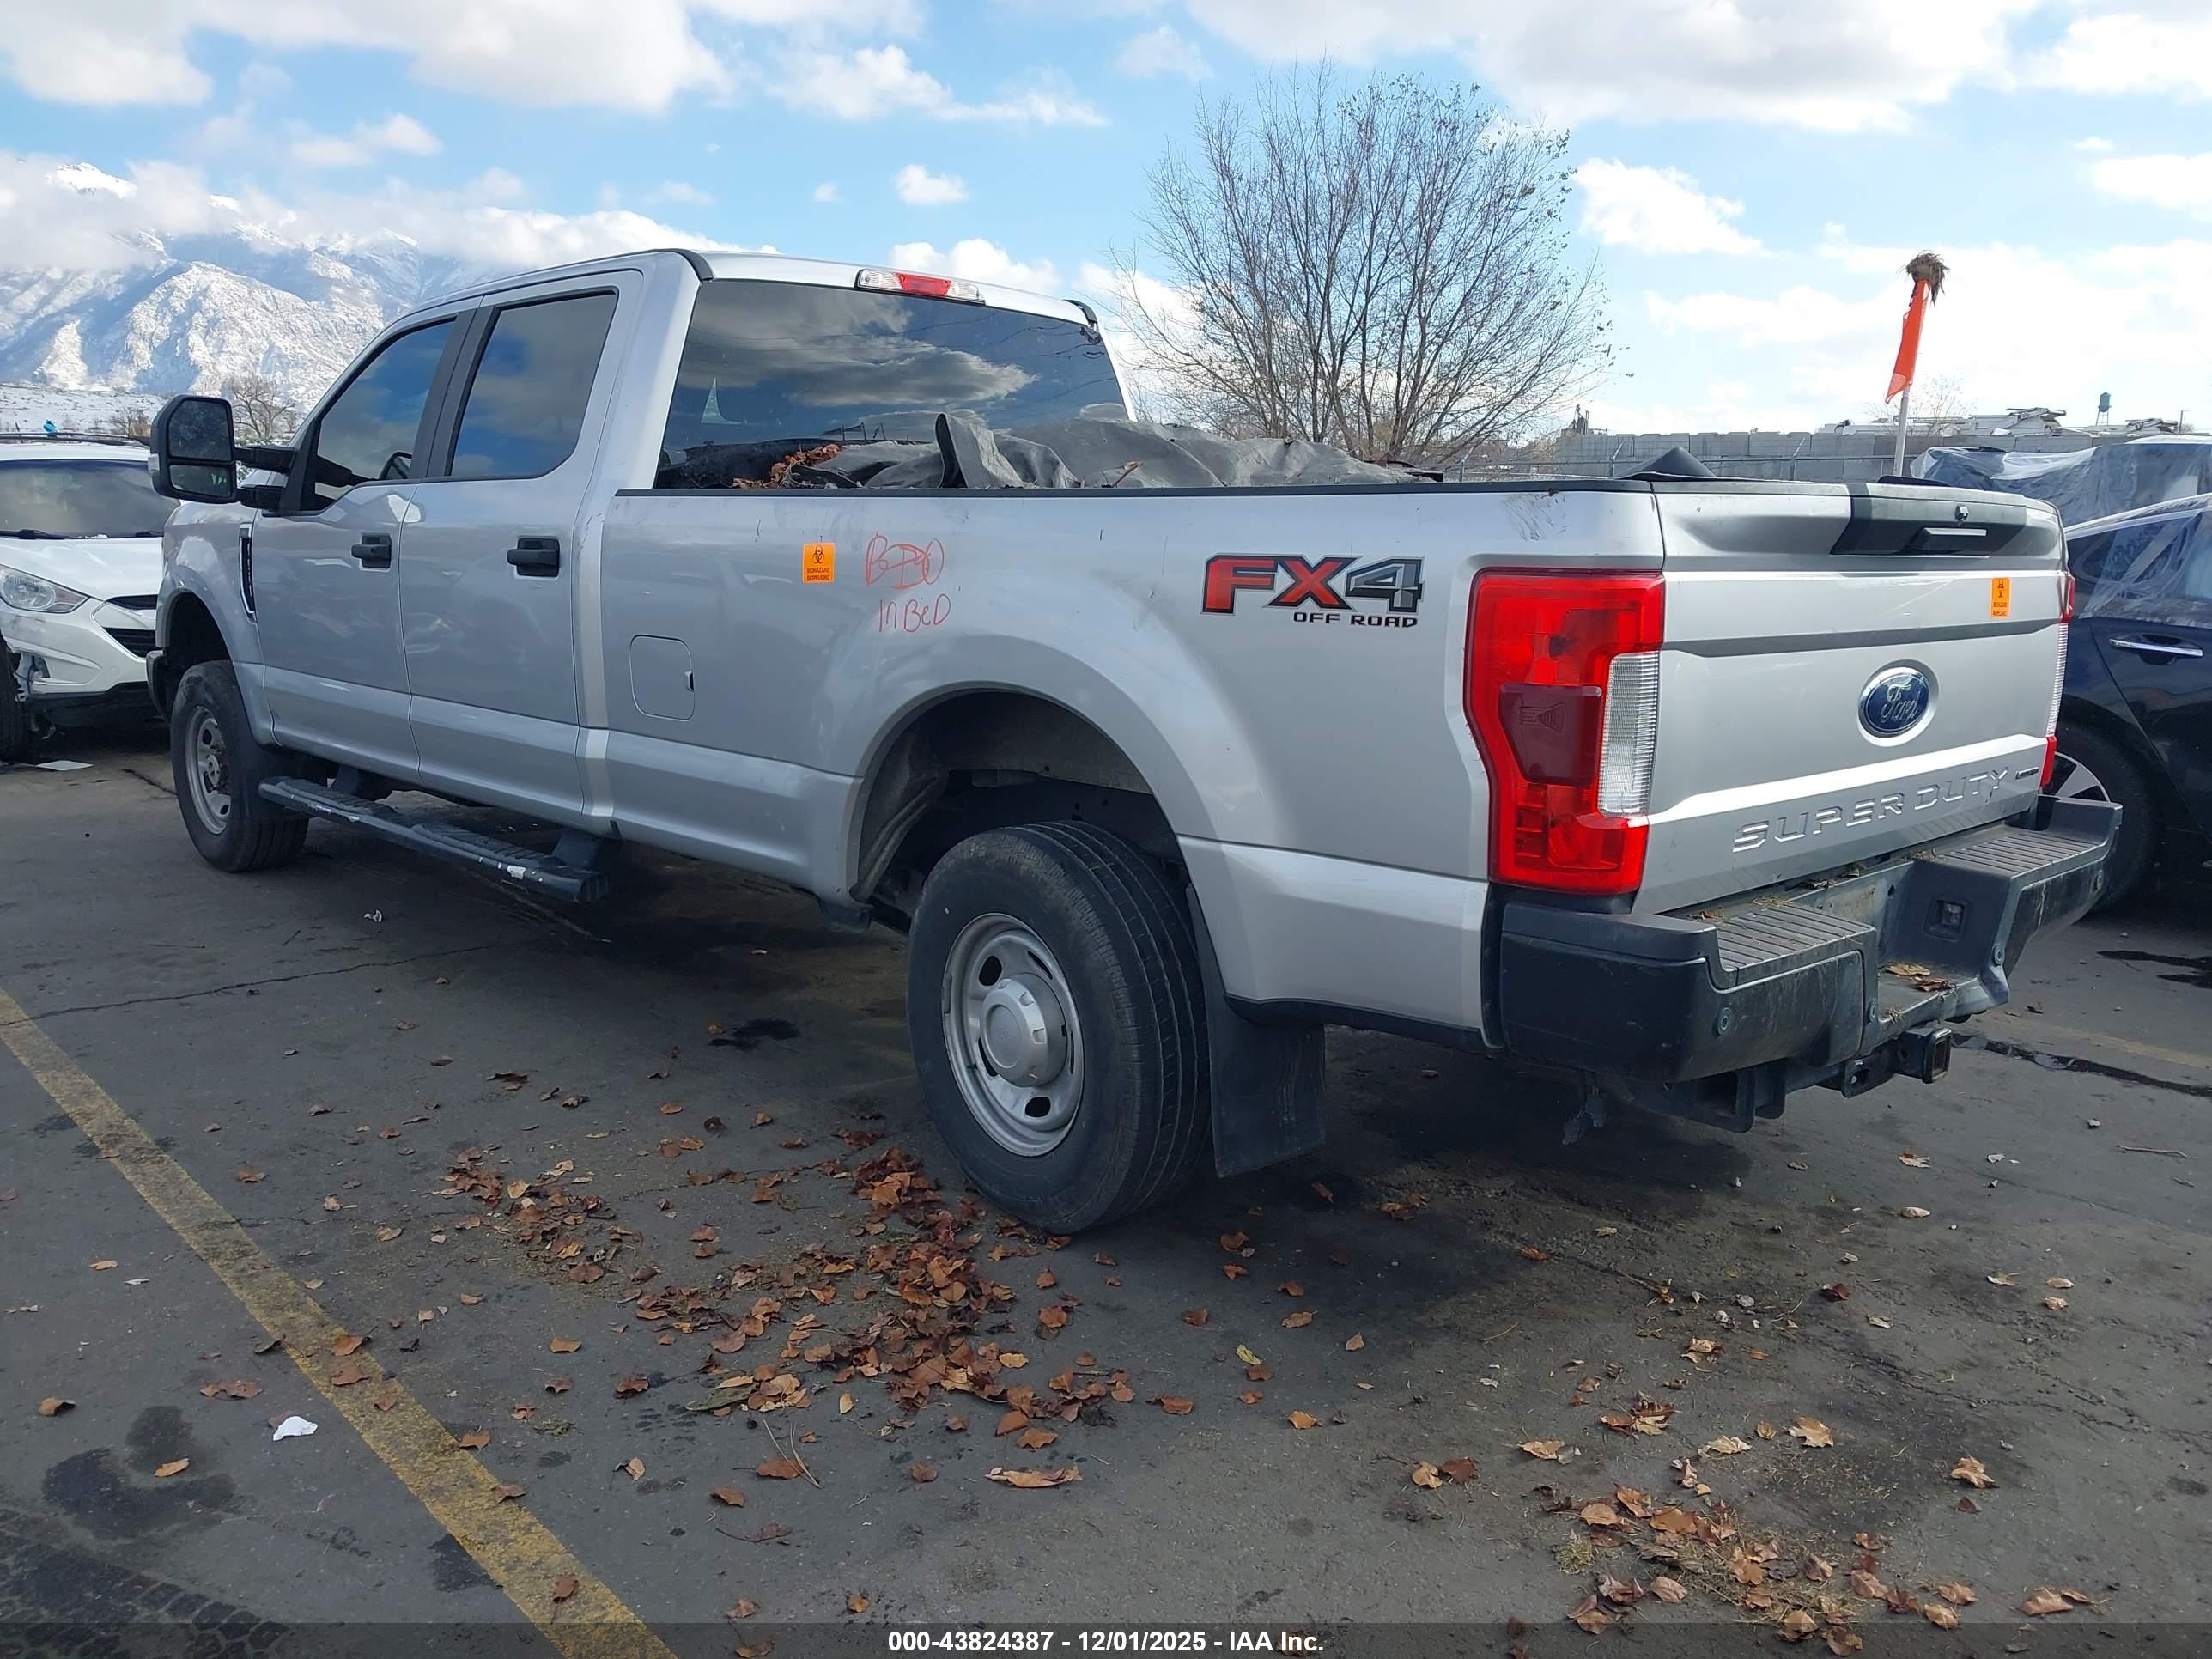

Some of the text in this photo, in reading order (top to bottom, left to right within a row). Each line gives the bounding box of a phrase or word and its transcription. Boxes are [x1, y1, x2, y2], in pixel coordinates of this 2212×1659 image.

[1202, 556, 1423, 612] FX4
[1293, 611, 1418, 629] OFF ROAD
[1881, 683, 1920, 723] Ford
[1732, 766, 2009, 853] SUPER DUTY
